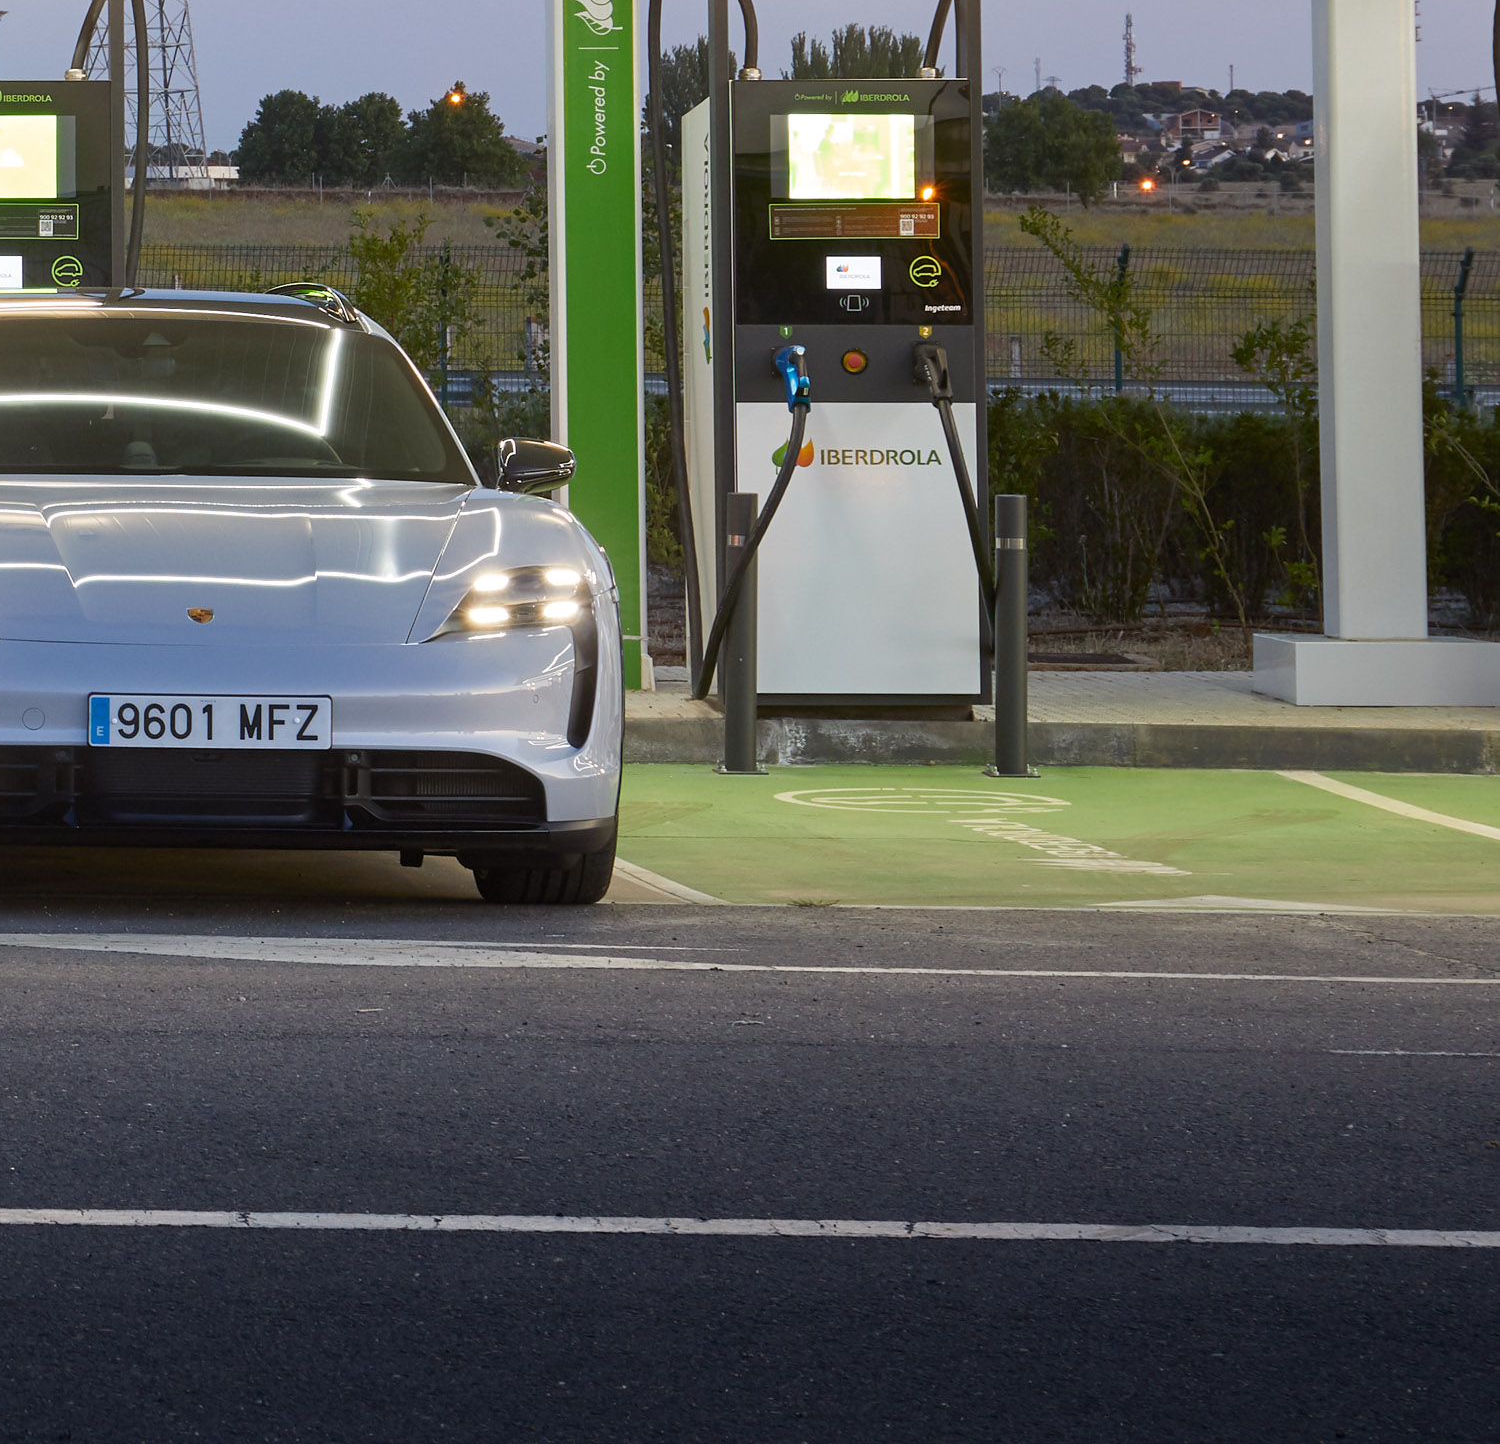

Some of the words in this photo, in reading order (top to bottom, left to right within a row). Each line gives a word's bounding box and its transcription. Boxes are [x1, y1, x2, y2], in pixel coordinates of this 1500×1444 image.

[587, 59, 611, 81] by
[3, 94, 53, 103] IBERDROLA
[800, 94, 824, 102] Powered
[824, 94, 833, 102] by
[859, 94, 910, 103] IBERDROLA
[587, 86, 607, 156] Powered
[924, 304, 962, 314] Ingeteam
[783, 327, 789, 336] 1
[923, 327, 929, 336] 2
[820, 449, 942, 466] IBERDROLA
[117, 702, 214, 740] 9601
[239, 703, 319, 741] MFZ
[97, 726, 104, 736] E
